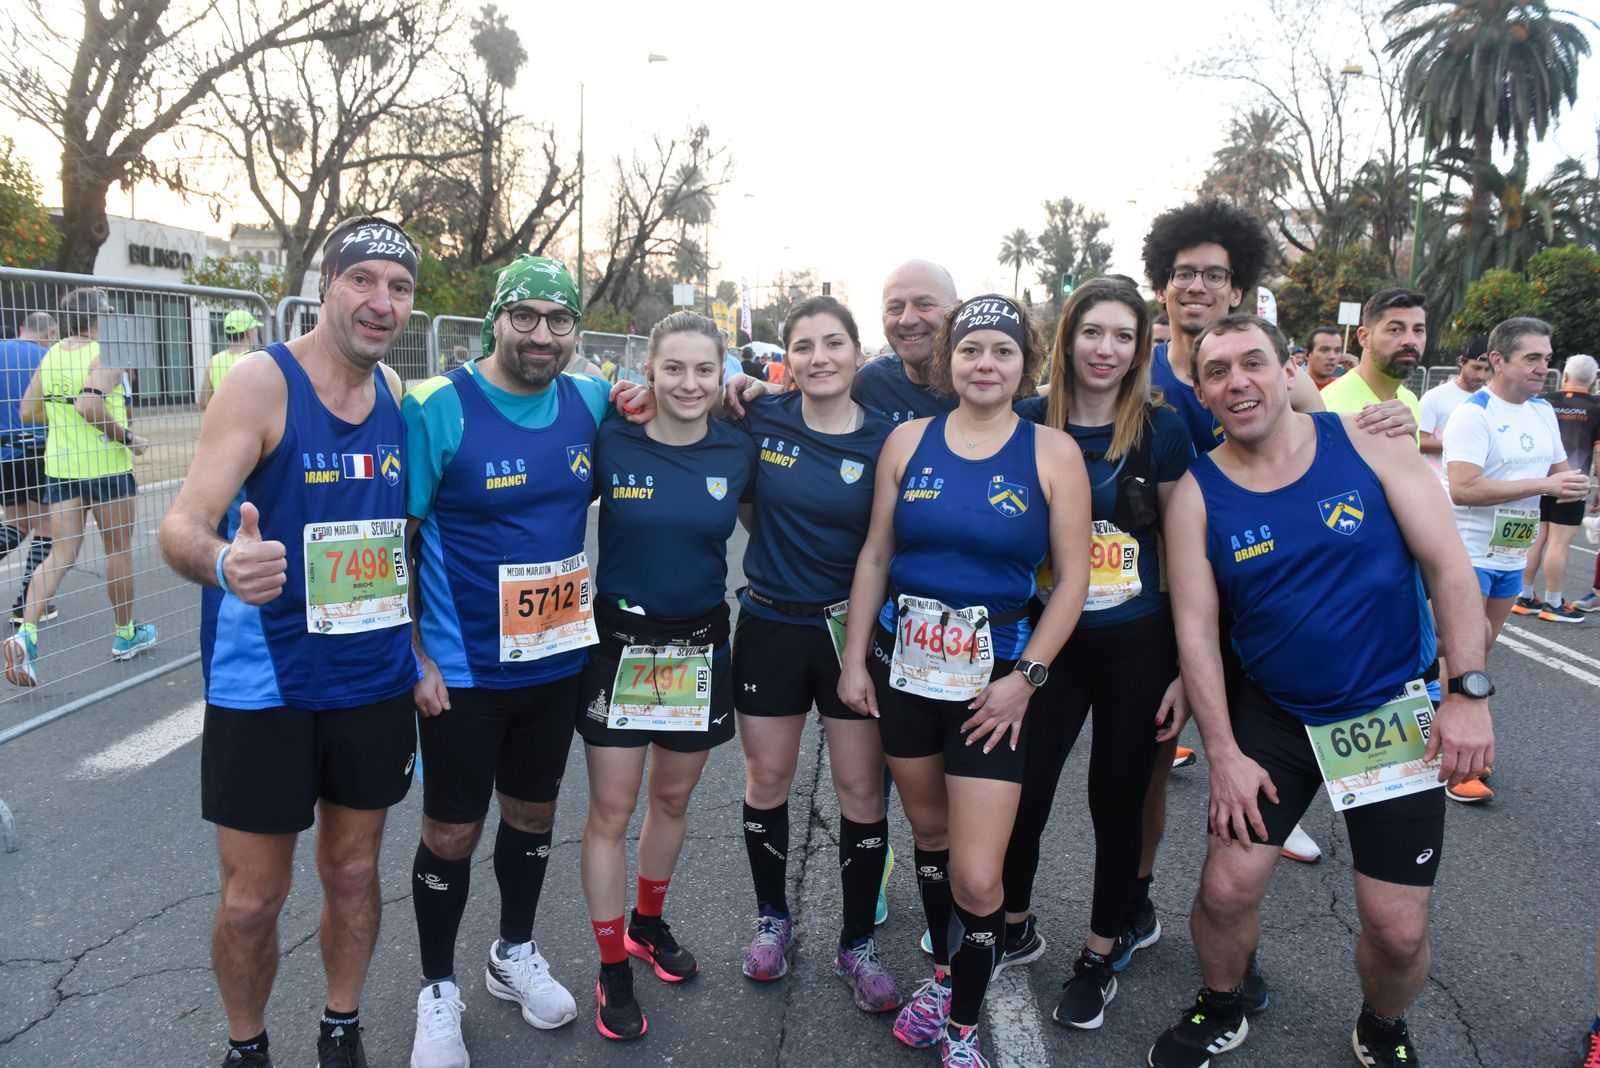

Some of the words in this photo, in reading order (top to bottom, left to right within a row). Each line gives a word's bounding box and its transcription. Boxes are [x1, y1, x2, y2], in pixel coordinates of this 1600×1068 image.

[340, 227, 417, 258] SEVILL
[365, 241, 407, 258] 2024
[953, 302, 1020, 332] SEVILLA
[967, 314, 1000, 328] 2024
[760, 448, 797, 469] DRANCY
[486, 473, 527, 490] DRANCY
[613, 486, 654, 499] DRANCY
[371, 521, 395, 536] SEVILLA
[1094, 521, 1120, 534] SEVIL
[1502, 521, 1534, 539] 6726
[1234, 539, 1275, 563] DRANCY
[325, 546, 390, 584] 7498
[507, 567, 525, 577] MEDIO
[561, 556, 580, 573] SEVILLA
[518, 581, 574, 617] 5712
[904, 618, 979, 660] 14834
[632, 664, 689, 690] 7497
[1330, 712, 1408, 757] 6621
